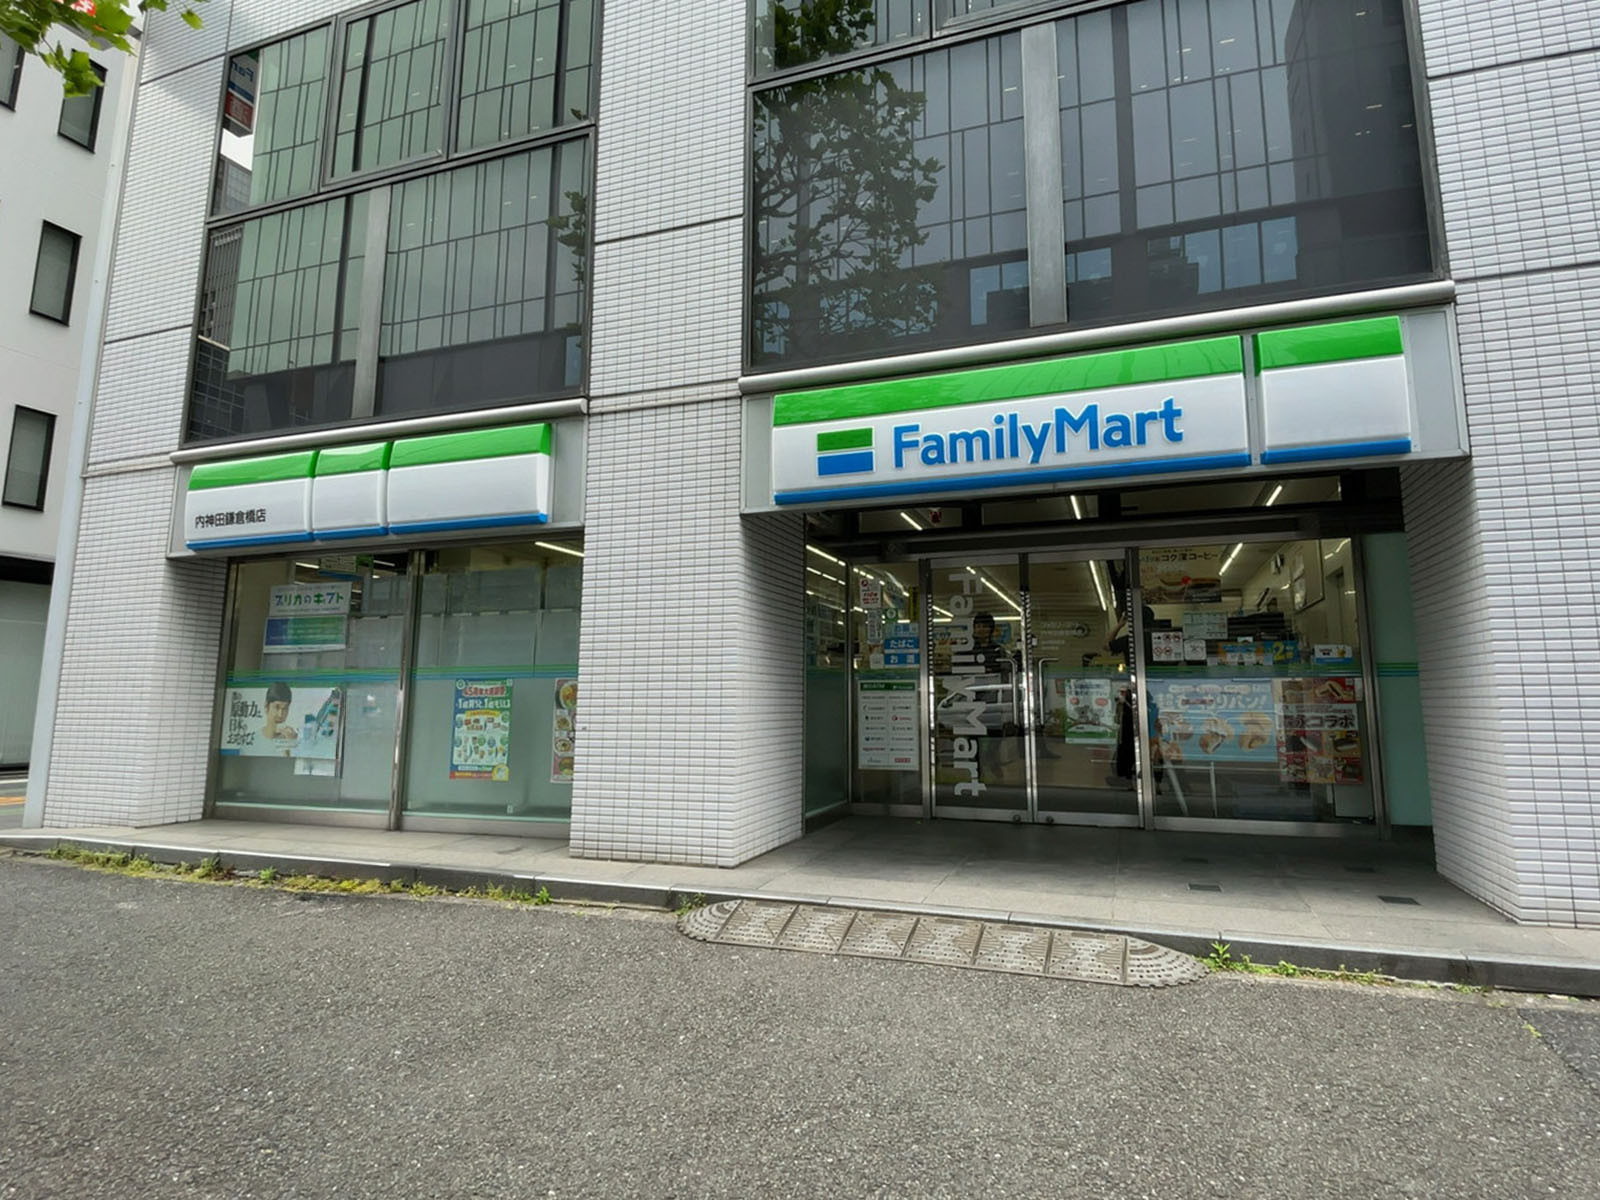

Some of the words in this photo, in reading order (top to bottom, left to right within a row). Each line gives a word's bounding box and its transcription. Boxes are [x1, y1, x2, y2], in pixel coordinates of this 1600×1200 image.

[893, 397, 1184, 467] FamilyMart
[195, 508, 266, 528] 内神田鎌倉橋店
[889, 639, 915, 649] たばこ
[943, 573, 988, 796] FamilyMart
